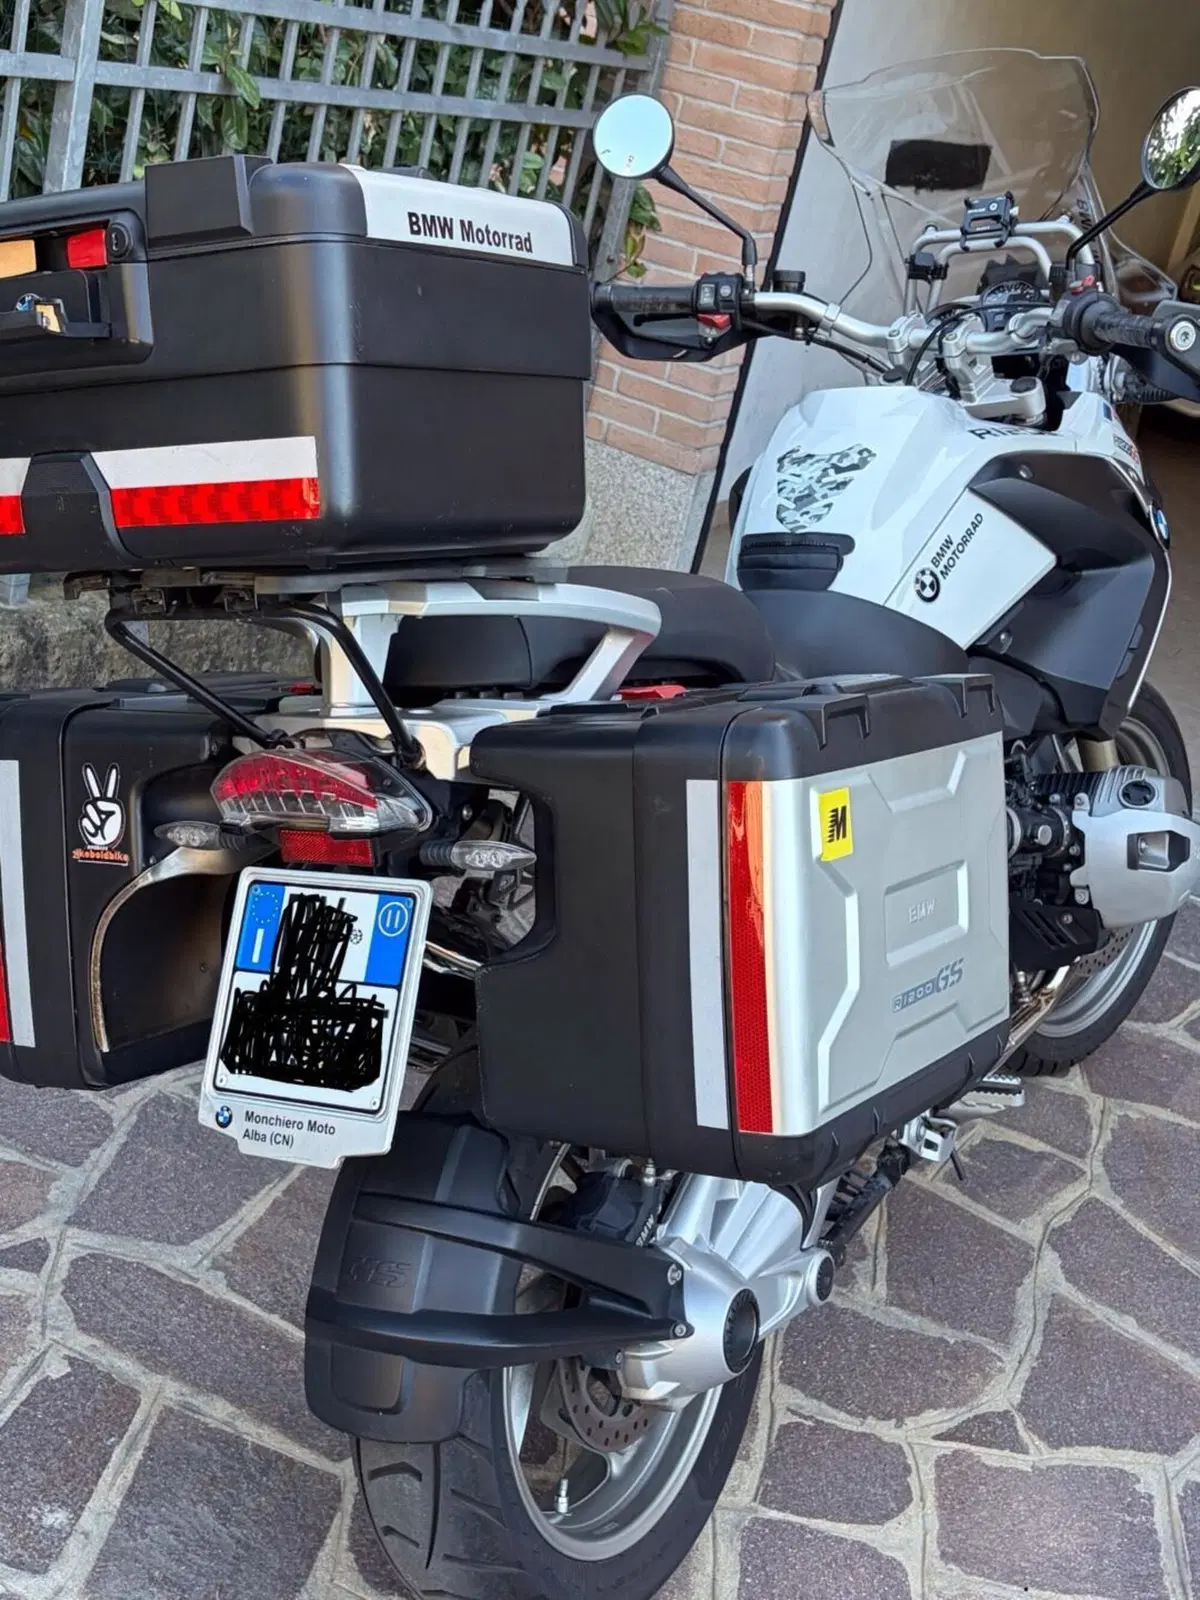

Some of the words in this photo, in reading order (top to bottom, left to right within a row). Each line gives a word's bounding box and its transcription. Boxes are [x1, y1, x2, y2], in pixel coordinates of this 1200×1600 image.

[407, 211, 454, 240] BMW
[459, 219, 533, 253] Motorrad
[930, 534, 954, 568] BMW
[939, 512, 983, 580] MOTORRAD
[242, 1129, 267, 1143] Alba
[269, 1132, 294, 1149] (CN)
[244, 1110, 304, 1130] Monchiero
[307, 1120, 336, 1136] Moto
